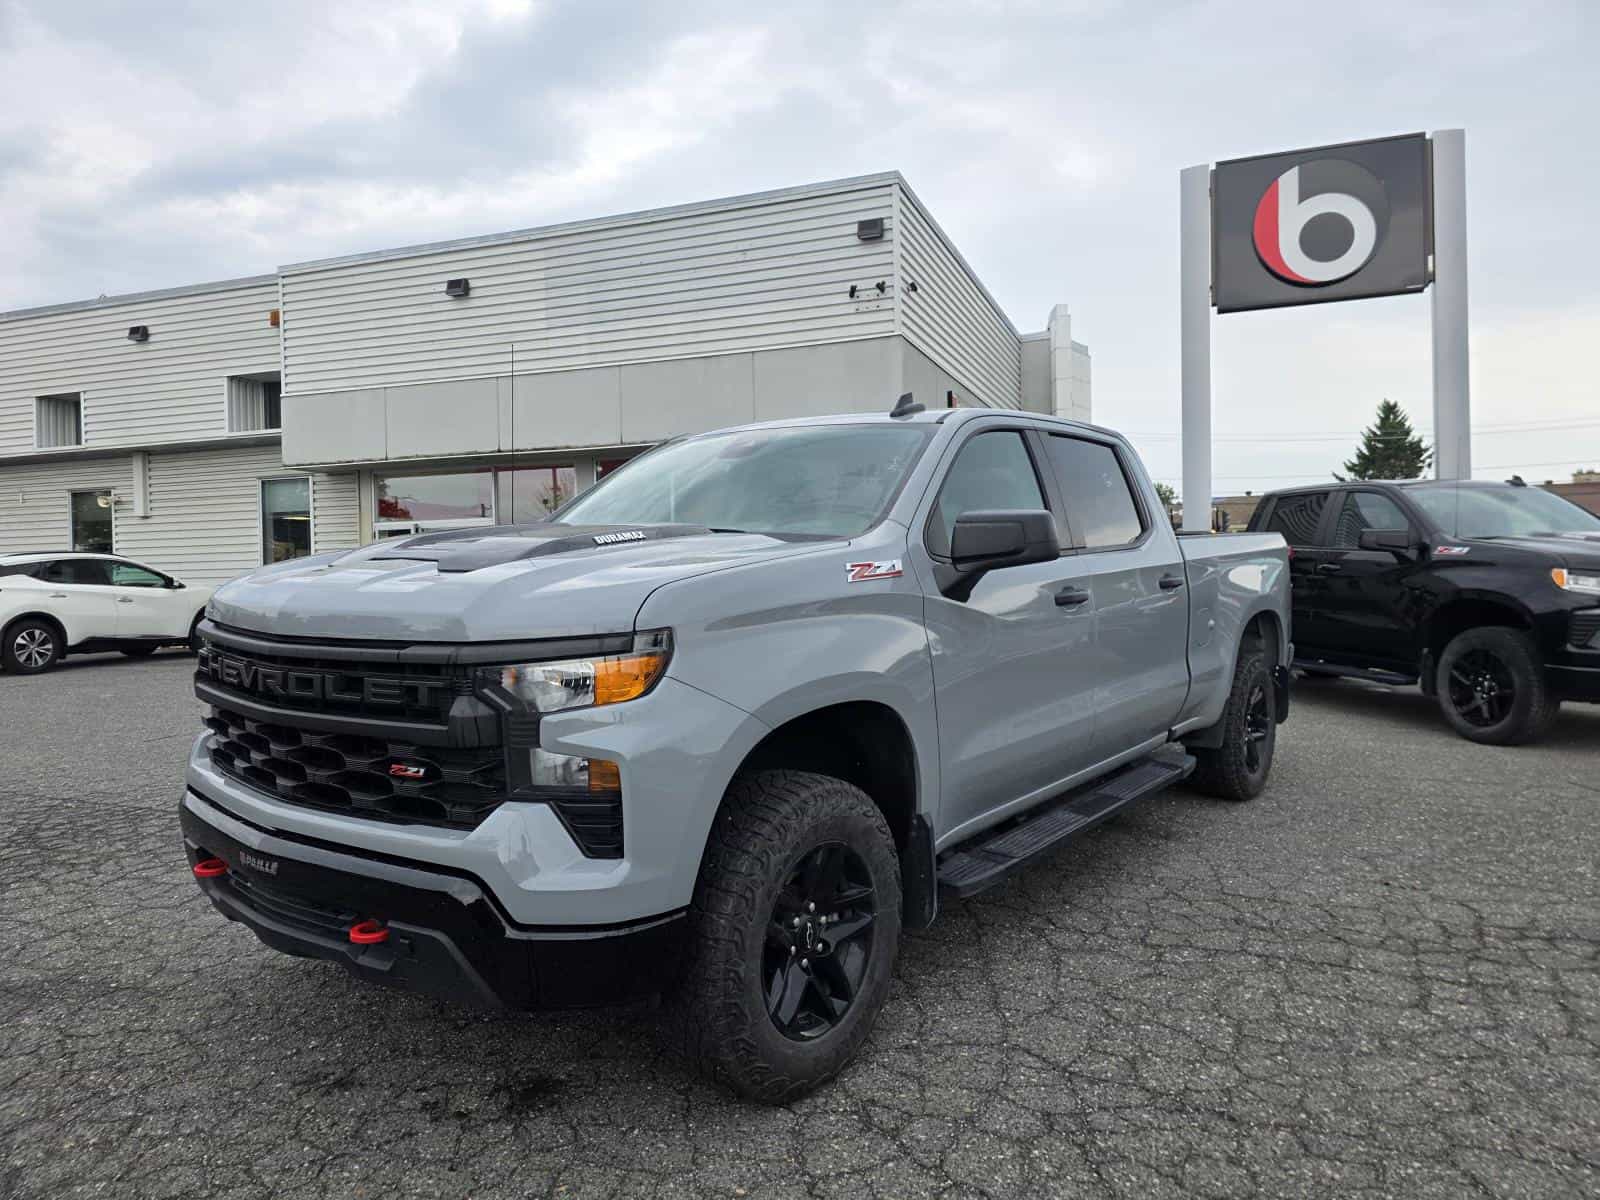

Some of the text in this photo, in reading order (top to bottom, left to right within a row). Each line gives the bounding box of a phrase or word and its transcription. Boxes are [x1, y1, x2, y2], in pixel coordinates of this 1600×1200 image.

[593, 531, 647, 544] DURAMAX
[846, 559, 904, 582] Z71
[198, 646, 447, 706] CHEVROLET
[390, 763, 425, 777] Z71
